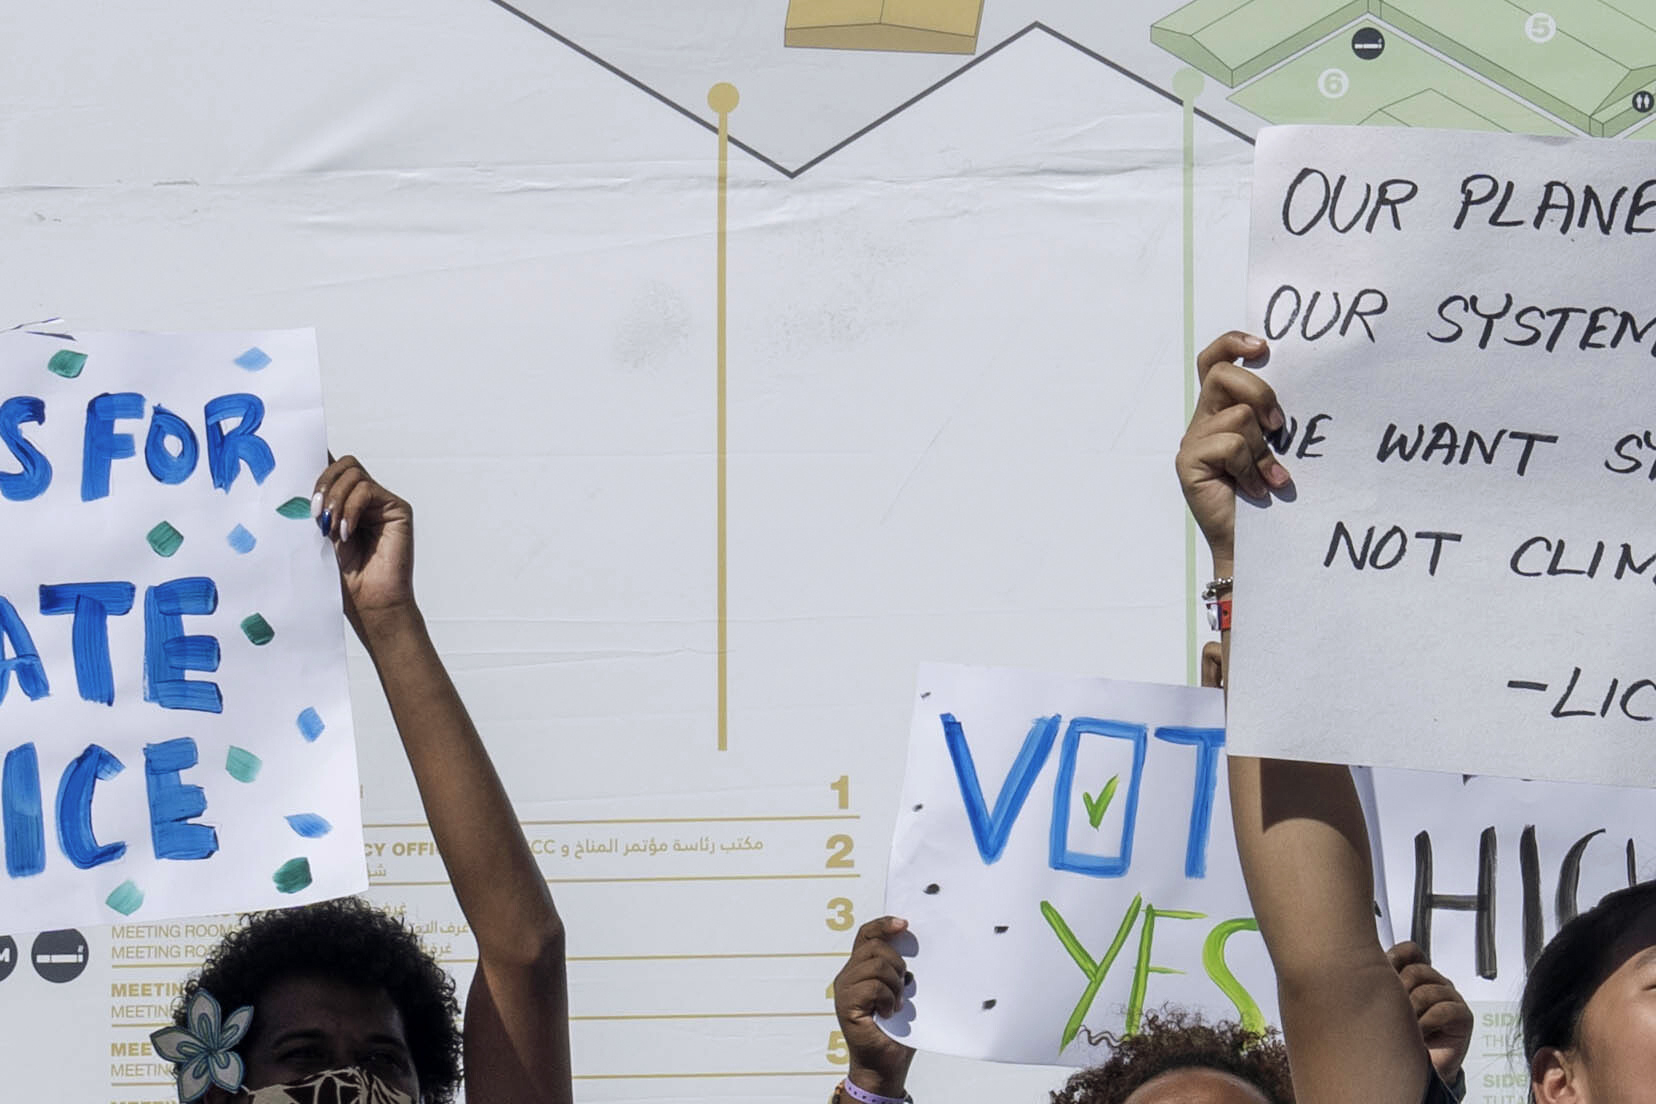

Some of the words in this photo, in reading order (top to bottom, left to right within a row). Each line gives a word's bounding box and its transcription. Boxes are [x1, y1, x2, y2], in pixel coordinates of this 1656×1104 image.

[1281, 167, 1418, 236] OUR
[1264, 284, 1389, 344] OUR
[81, 391, 277, 503] FOR
[1377, 421, 1559, 477] WANT
[1323, 521, 1463, 577] NOT
[830, 775, 849, 810] 1
[940, 711, 1226, 879] VOT
[391, 842, 439, 857] OFFI
[573, 837, 619, 860] المناخ
[622, 837, 669, 857] مؤتمر
[672, 836, 716, 856] رئاسة
[720, 835, 764, 853] مكتب
[825, 833, 855, 869] 2
[111, 924, 182, 939] MEETING
[826, 897, 855, 932] 3
[111, 944, 182, 960] MEETING
[111, 982, 185, 998] MEETIN
[826, 1030, 848, 1066] 5
